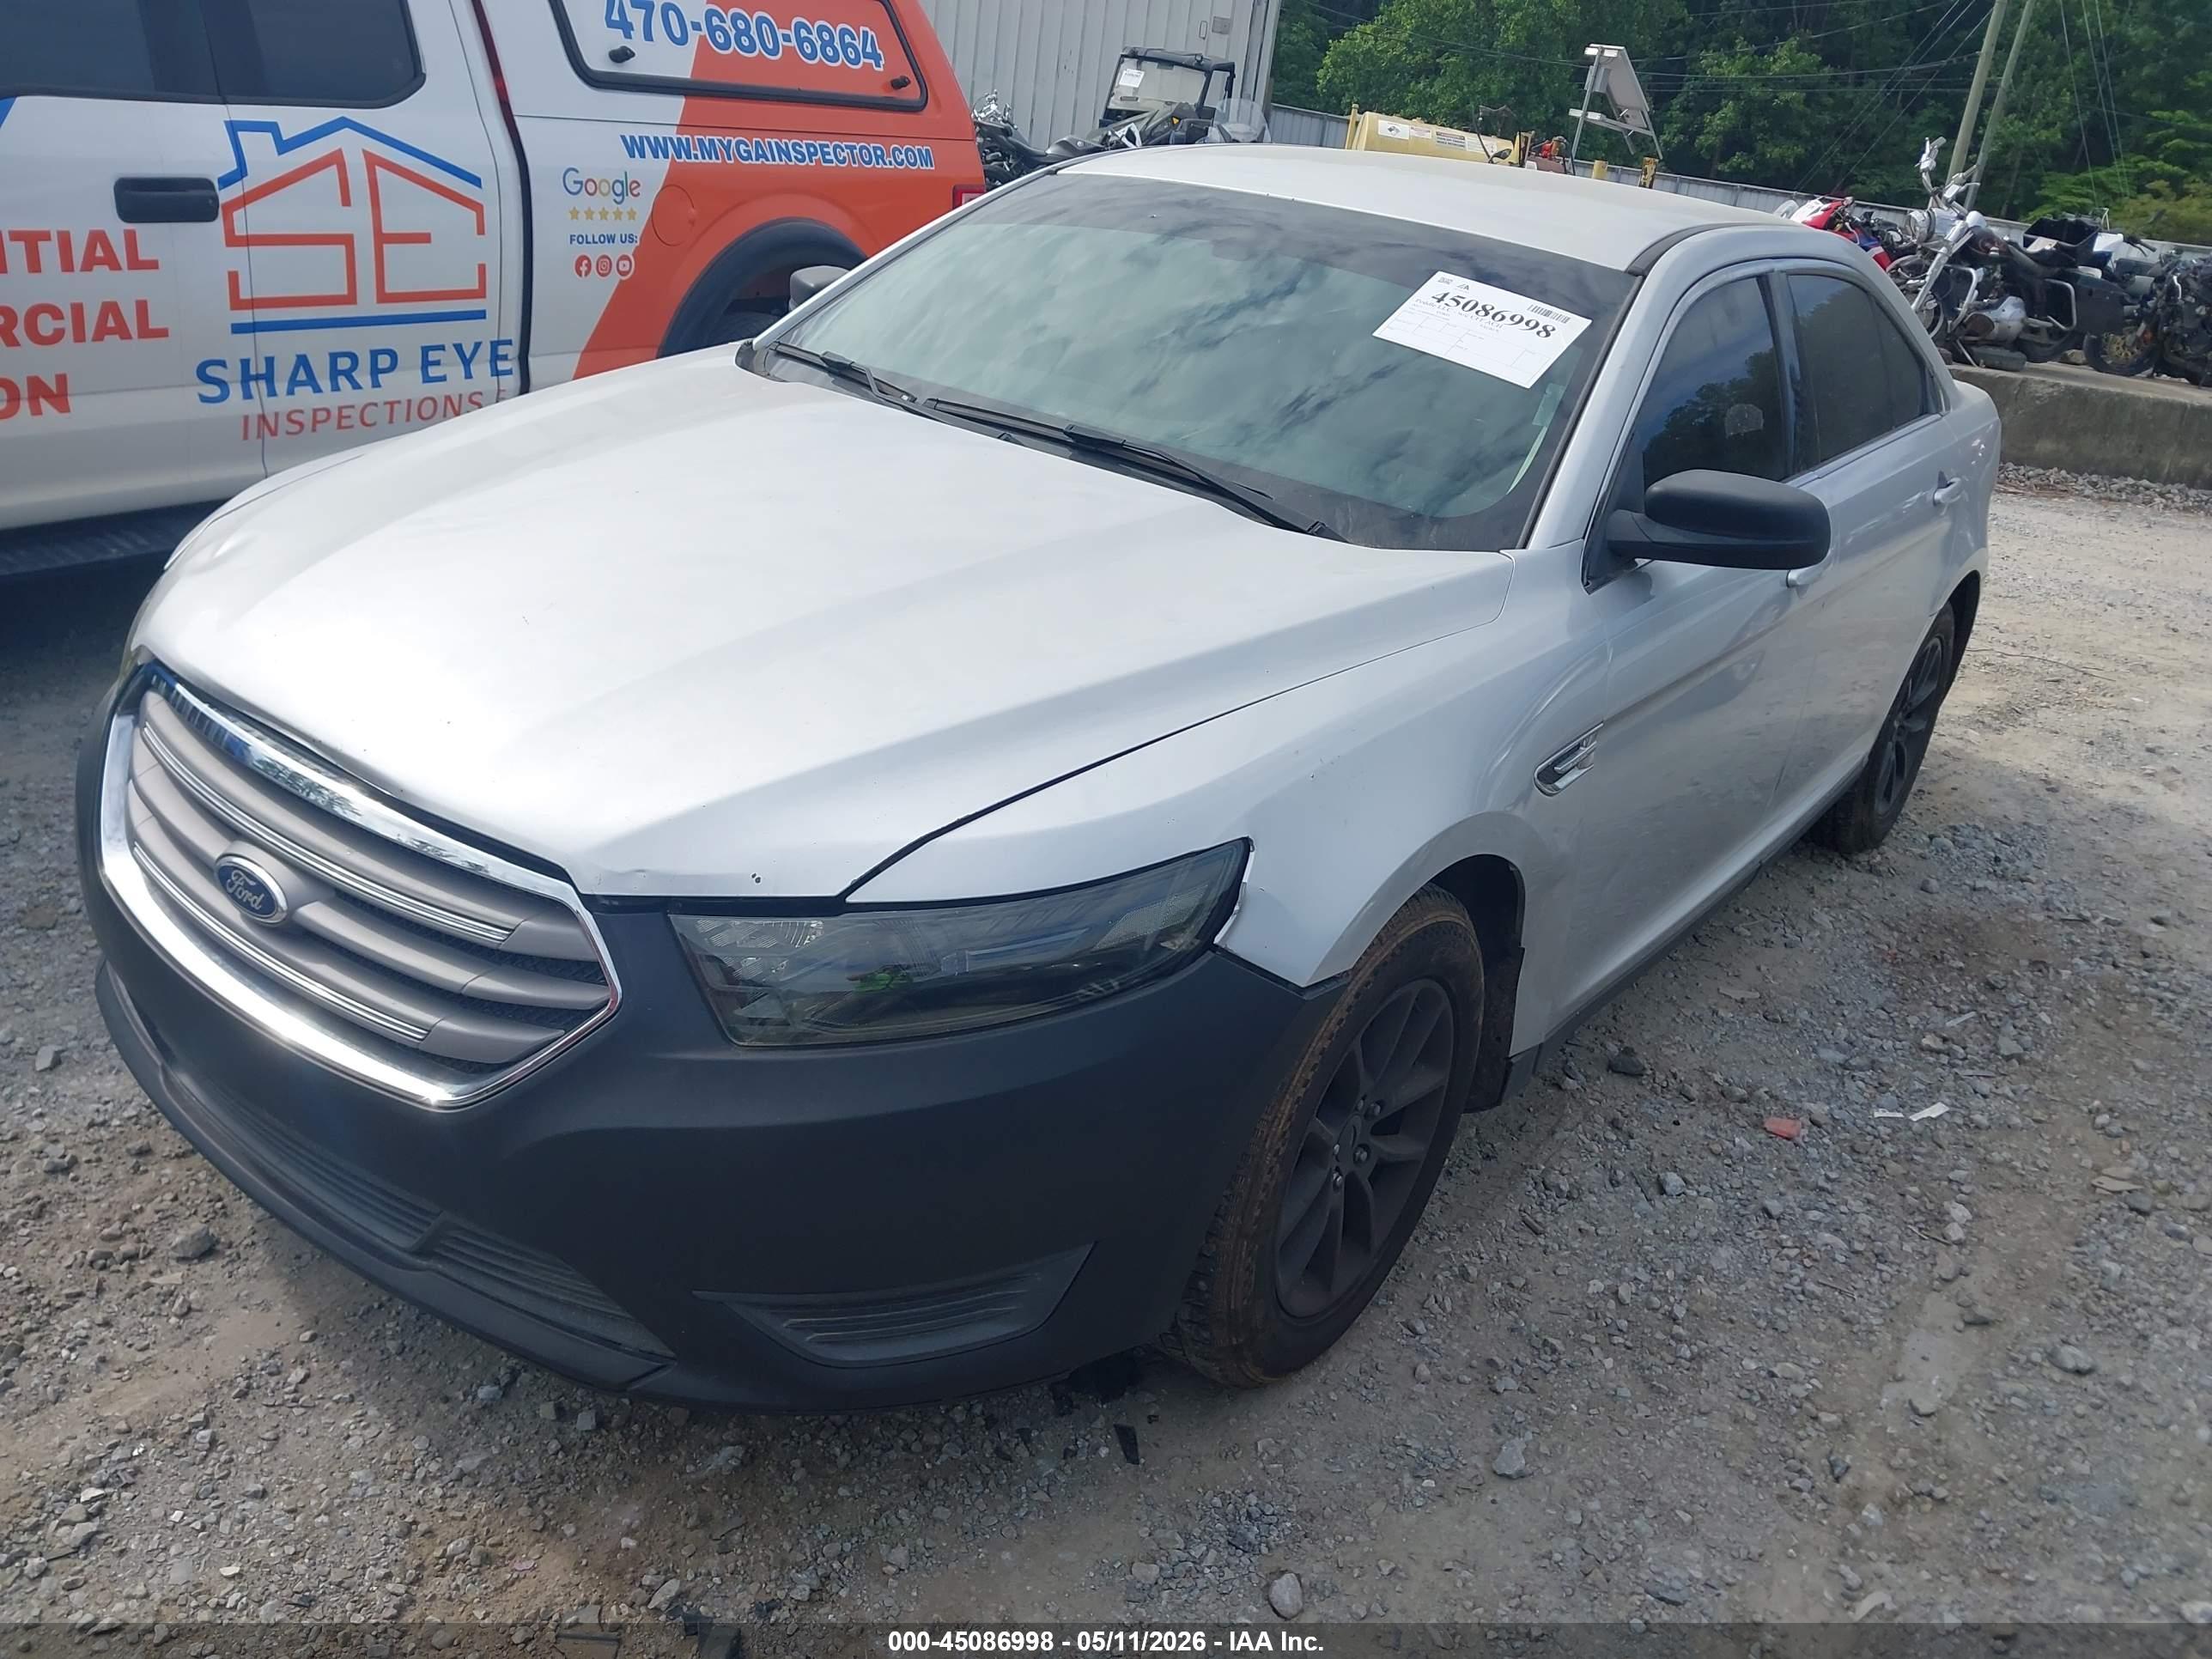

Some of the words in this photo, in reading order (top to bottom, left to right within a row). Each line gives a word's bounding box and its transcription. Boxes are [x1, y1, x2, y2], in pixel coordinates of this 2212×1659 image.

[605, 0, 884, 70] 470-680-6864
[620, 134, 934, 169] WWW.MYGAINSPECTOR.COM
[562, 167, 641, 205] Google
[0, 228, 160, 274] TIAL
[569, 234, 617, 245] FOLLOW
[620, 233, 638, 244] US:
[1431, 292, 1556, 338] 45086998
[196, 348, 398, 404] SHARP
[421, 339, 514, 384] EYE
[241, 391, 483, 441] INSPECTIONS
[226, 869, 265, 910] Ford
